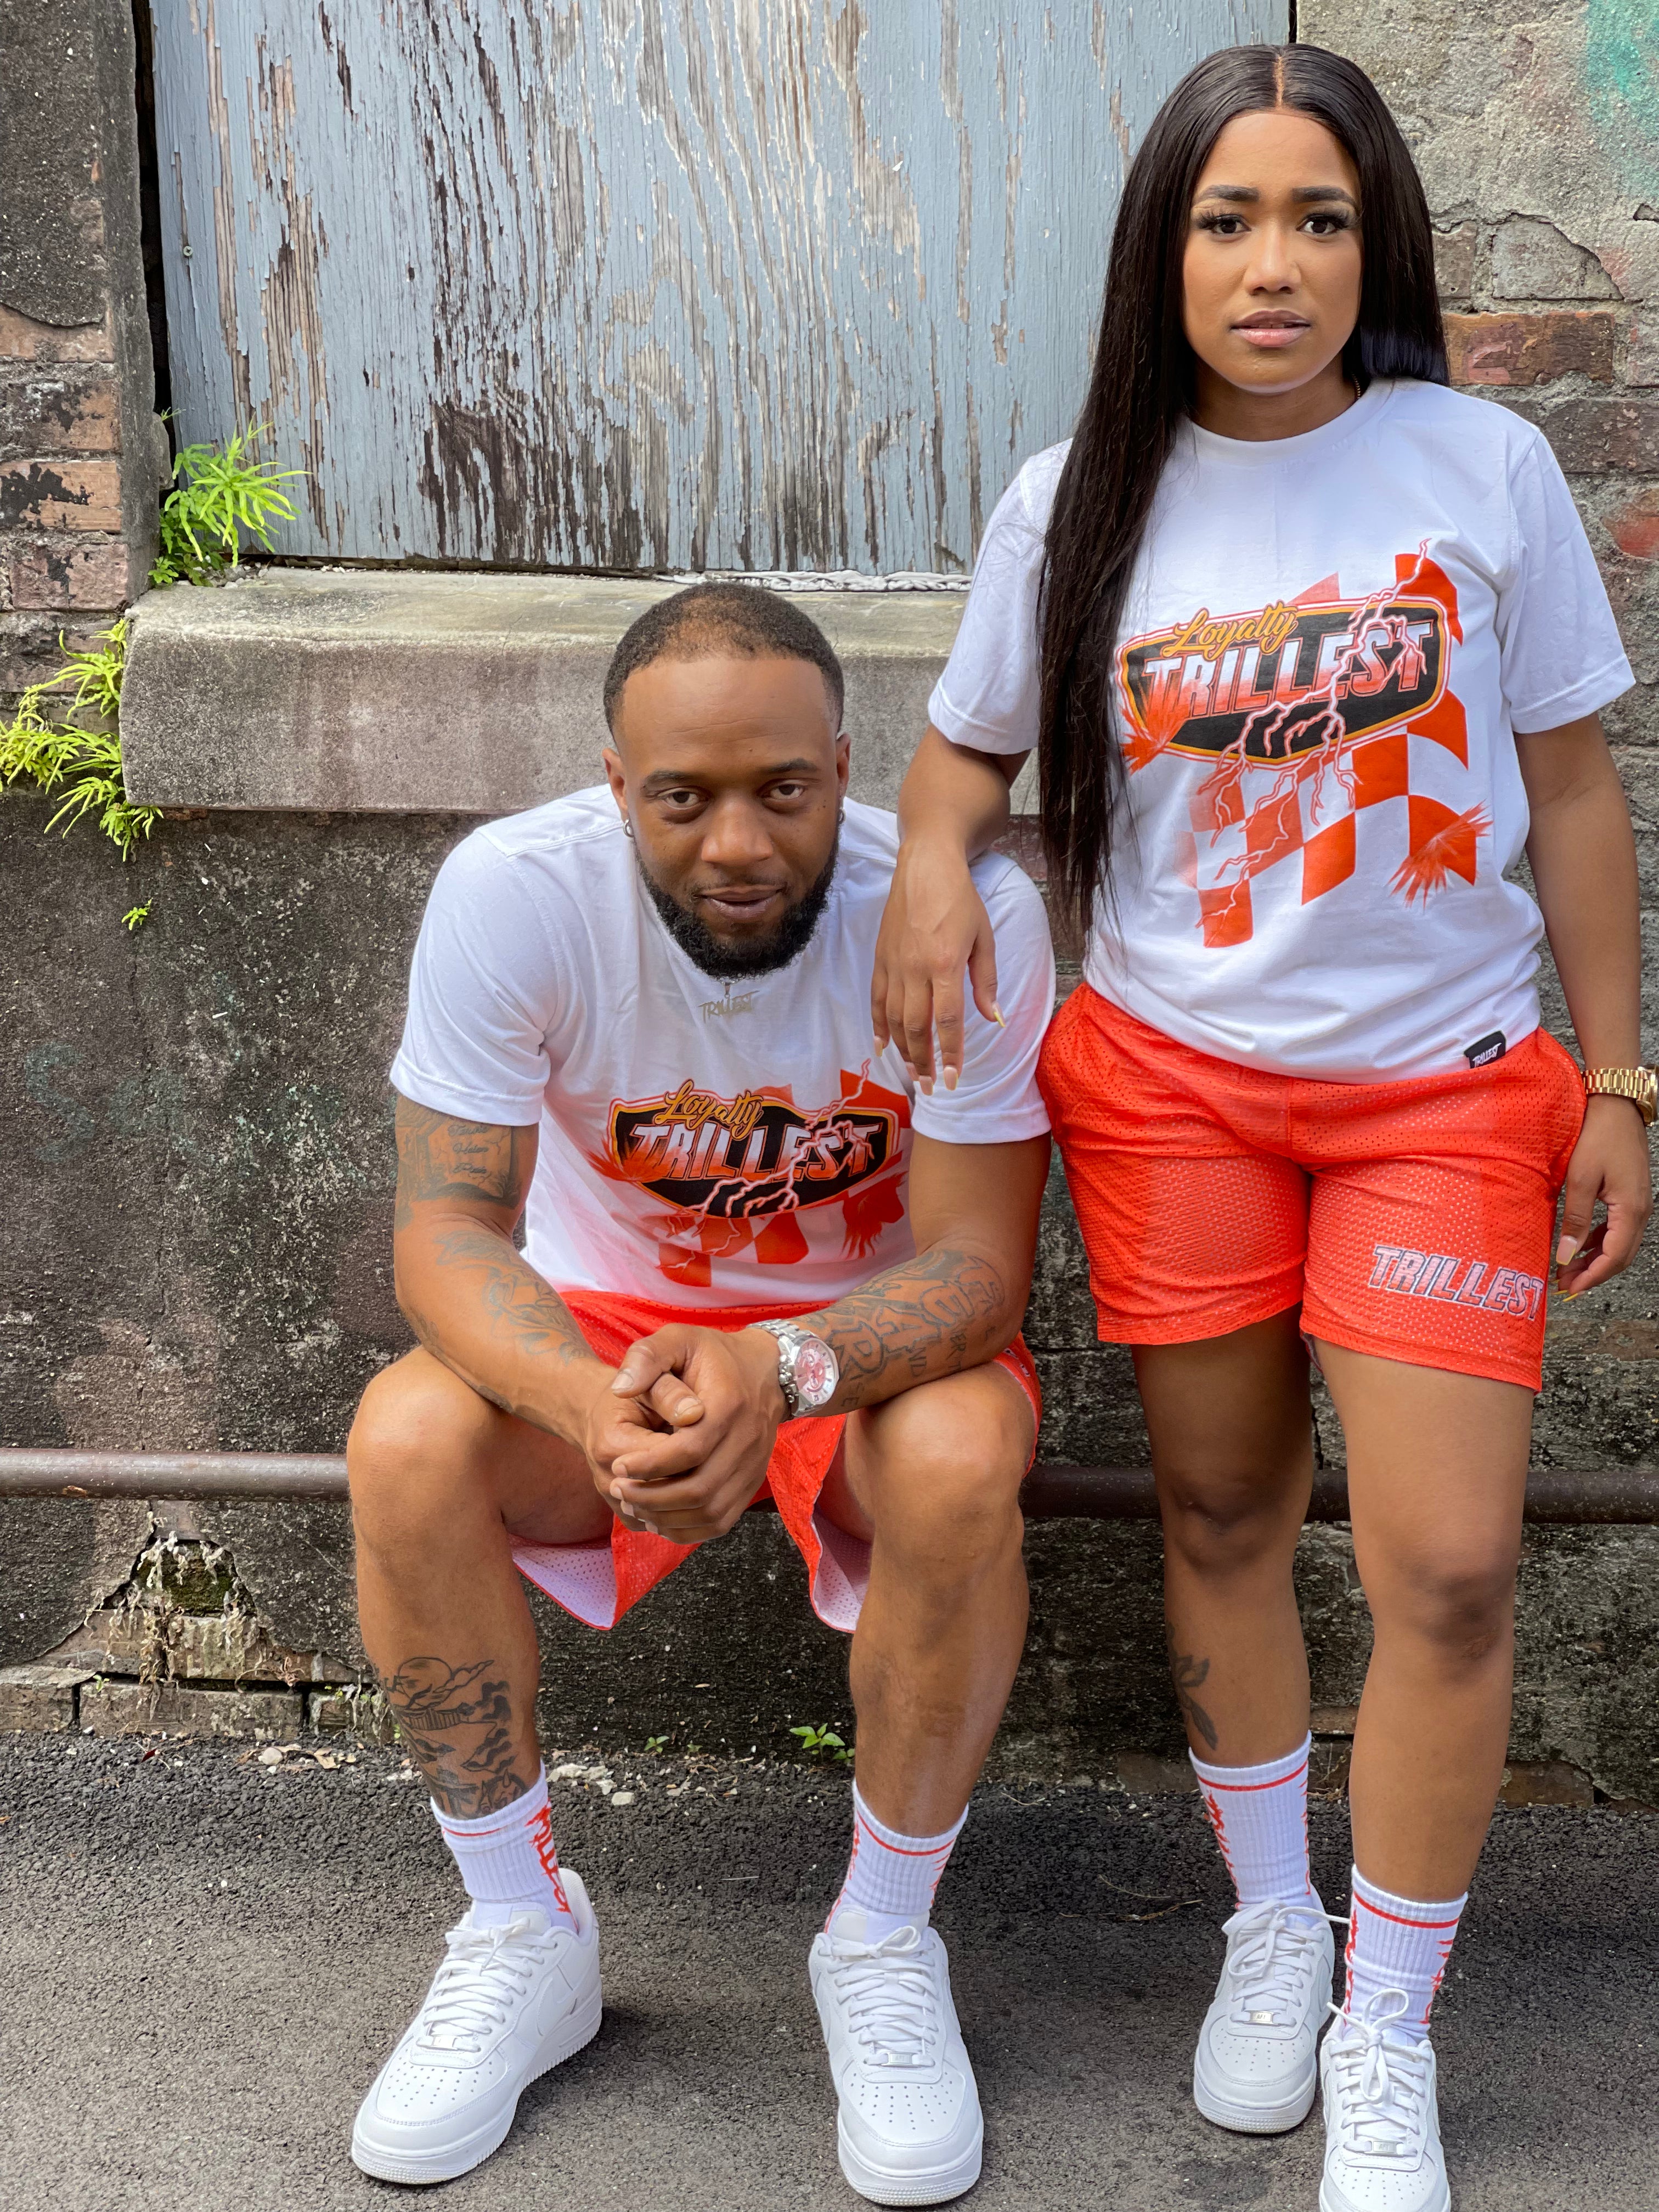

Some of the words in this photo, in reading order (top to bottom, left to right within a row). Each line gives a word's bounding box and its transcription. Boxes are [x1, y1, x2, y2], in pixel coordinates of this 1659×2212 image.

[1162, 600, 1298, 660] Loyalty
[1144, 619, 1433, 719] TRILLEST
[654, 1079, 764, 1139] Loyalty
[630, 1122, 881, 1182] TRILLEST
[1368, 1244, 1545, 1321] TRILLEST
